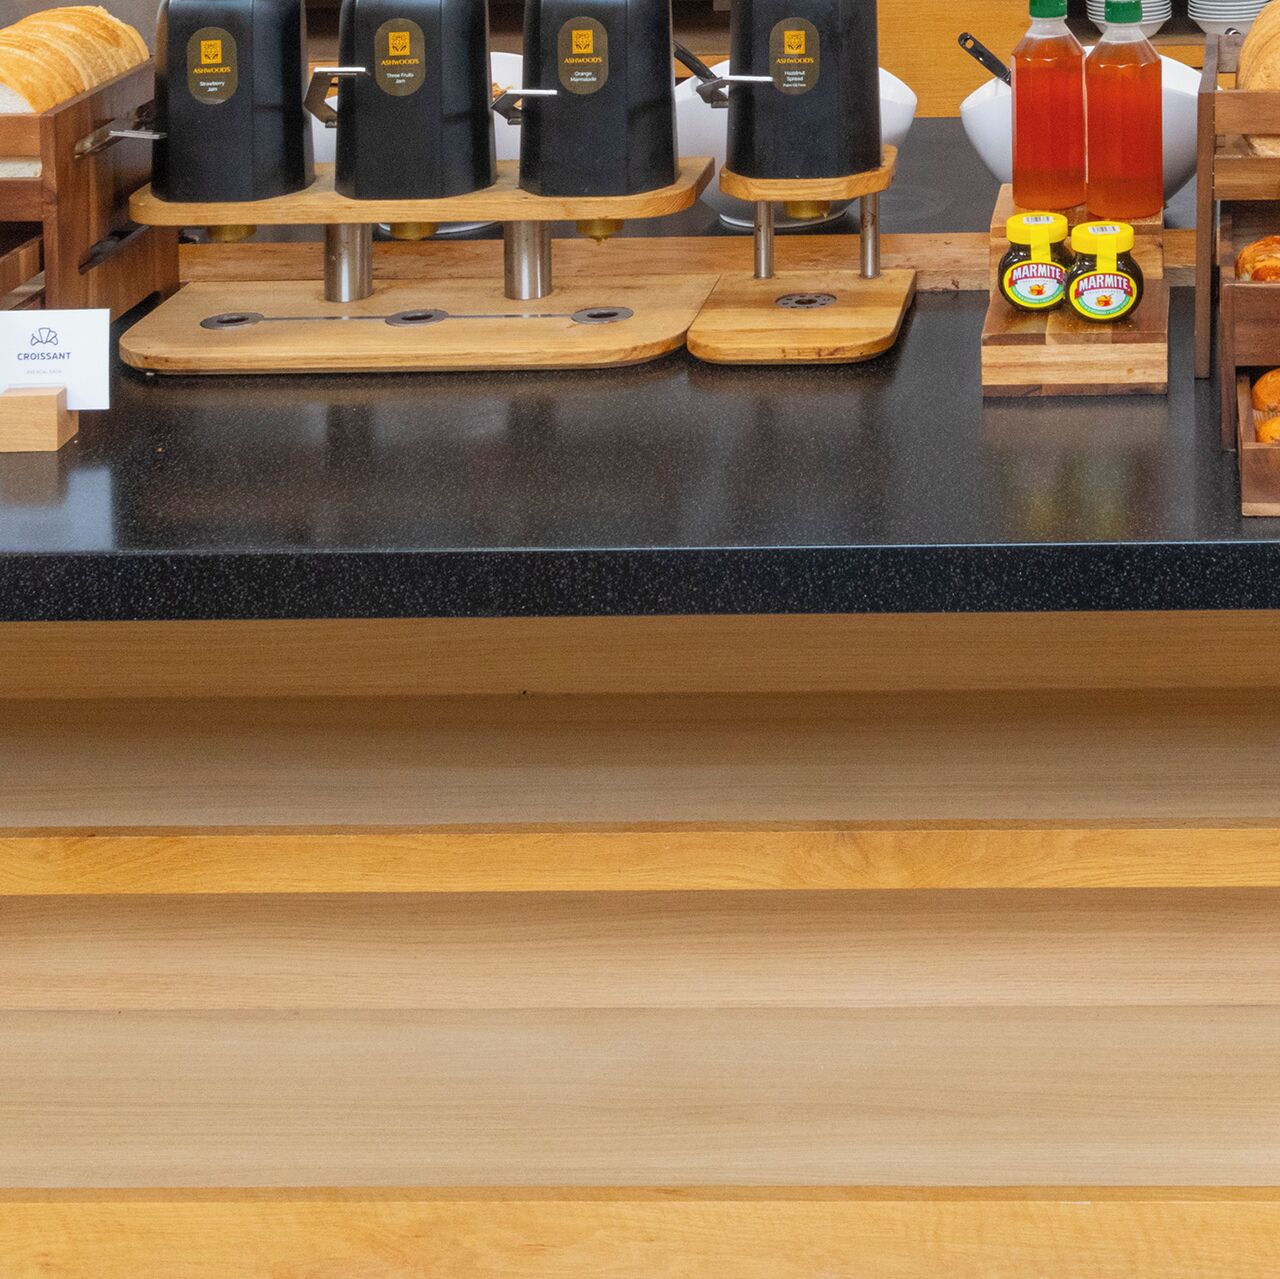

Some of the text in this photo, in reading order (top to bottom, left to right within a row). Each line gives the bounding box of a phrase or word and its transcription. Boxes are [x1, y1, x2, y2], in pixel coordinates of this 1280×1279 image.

[1012, 263, 1061, 281] MARMITE
[1079, 274, 1129, 292] MARMITE
[17, 351, 72, 361] CROISSANT
